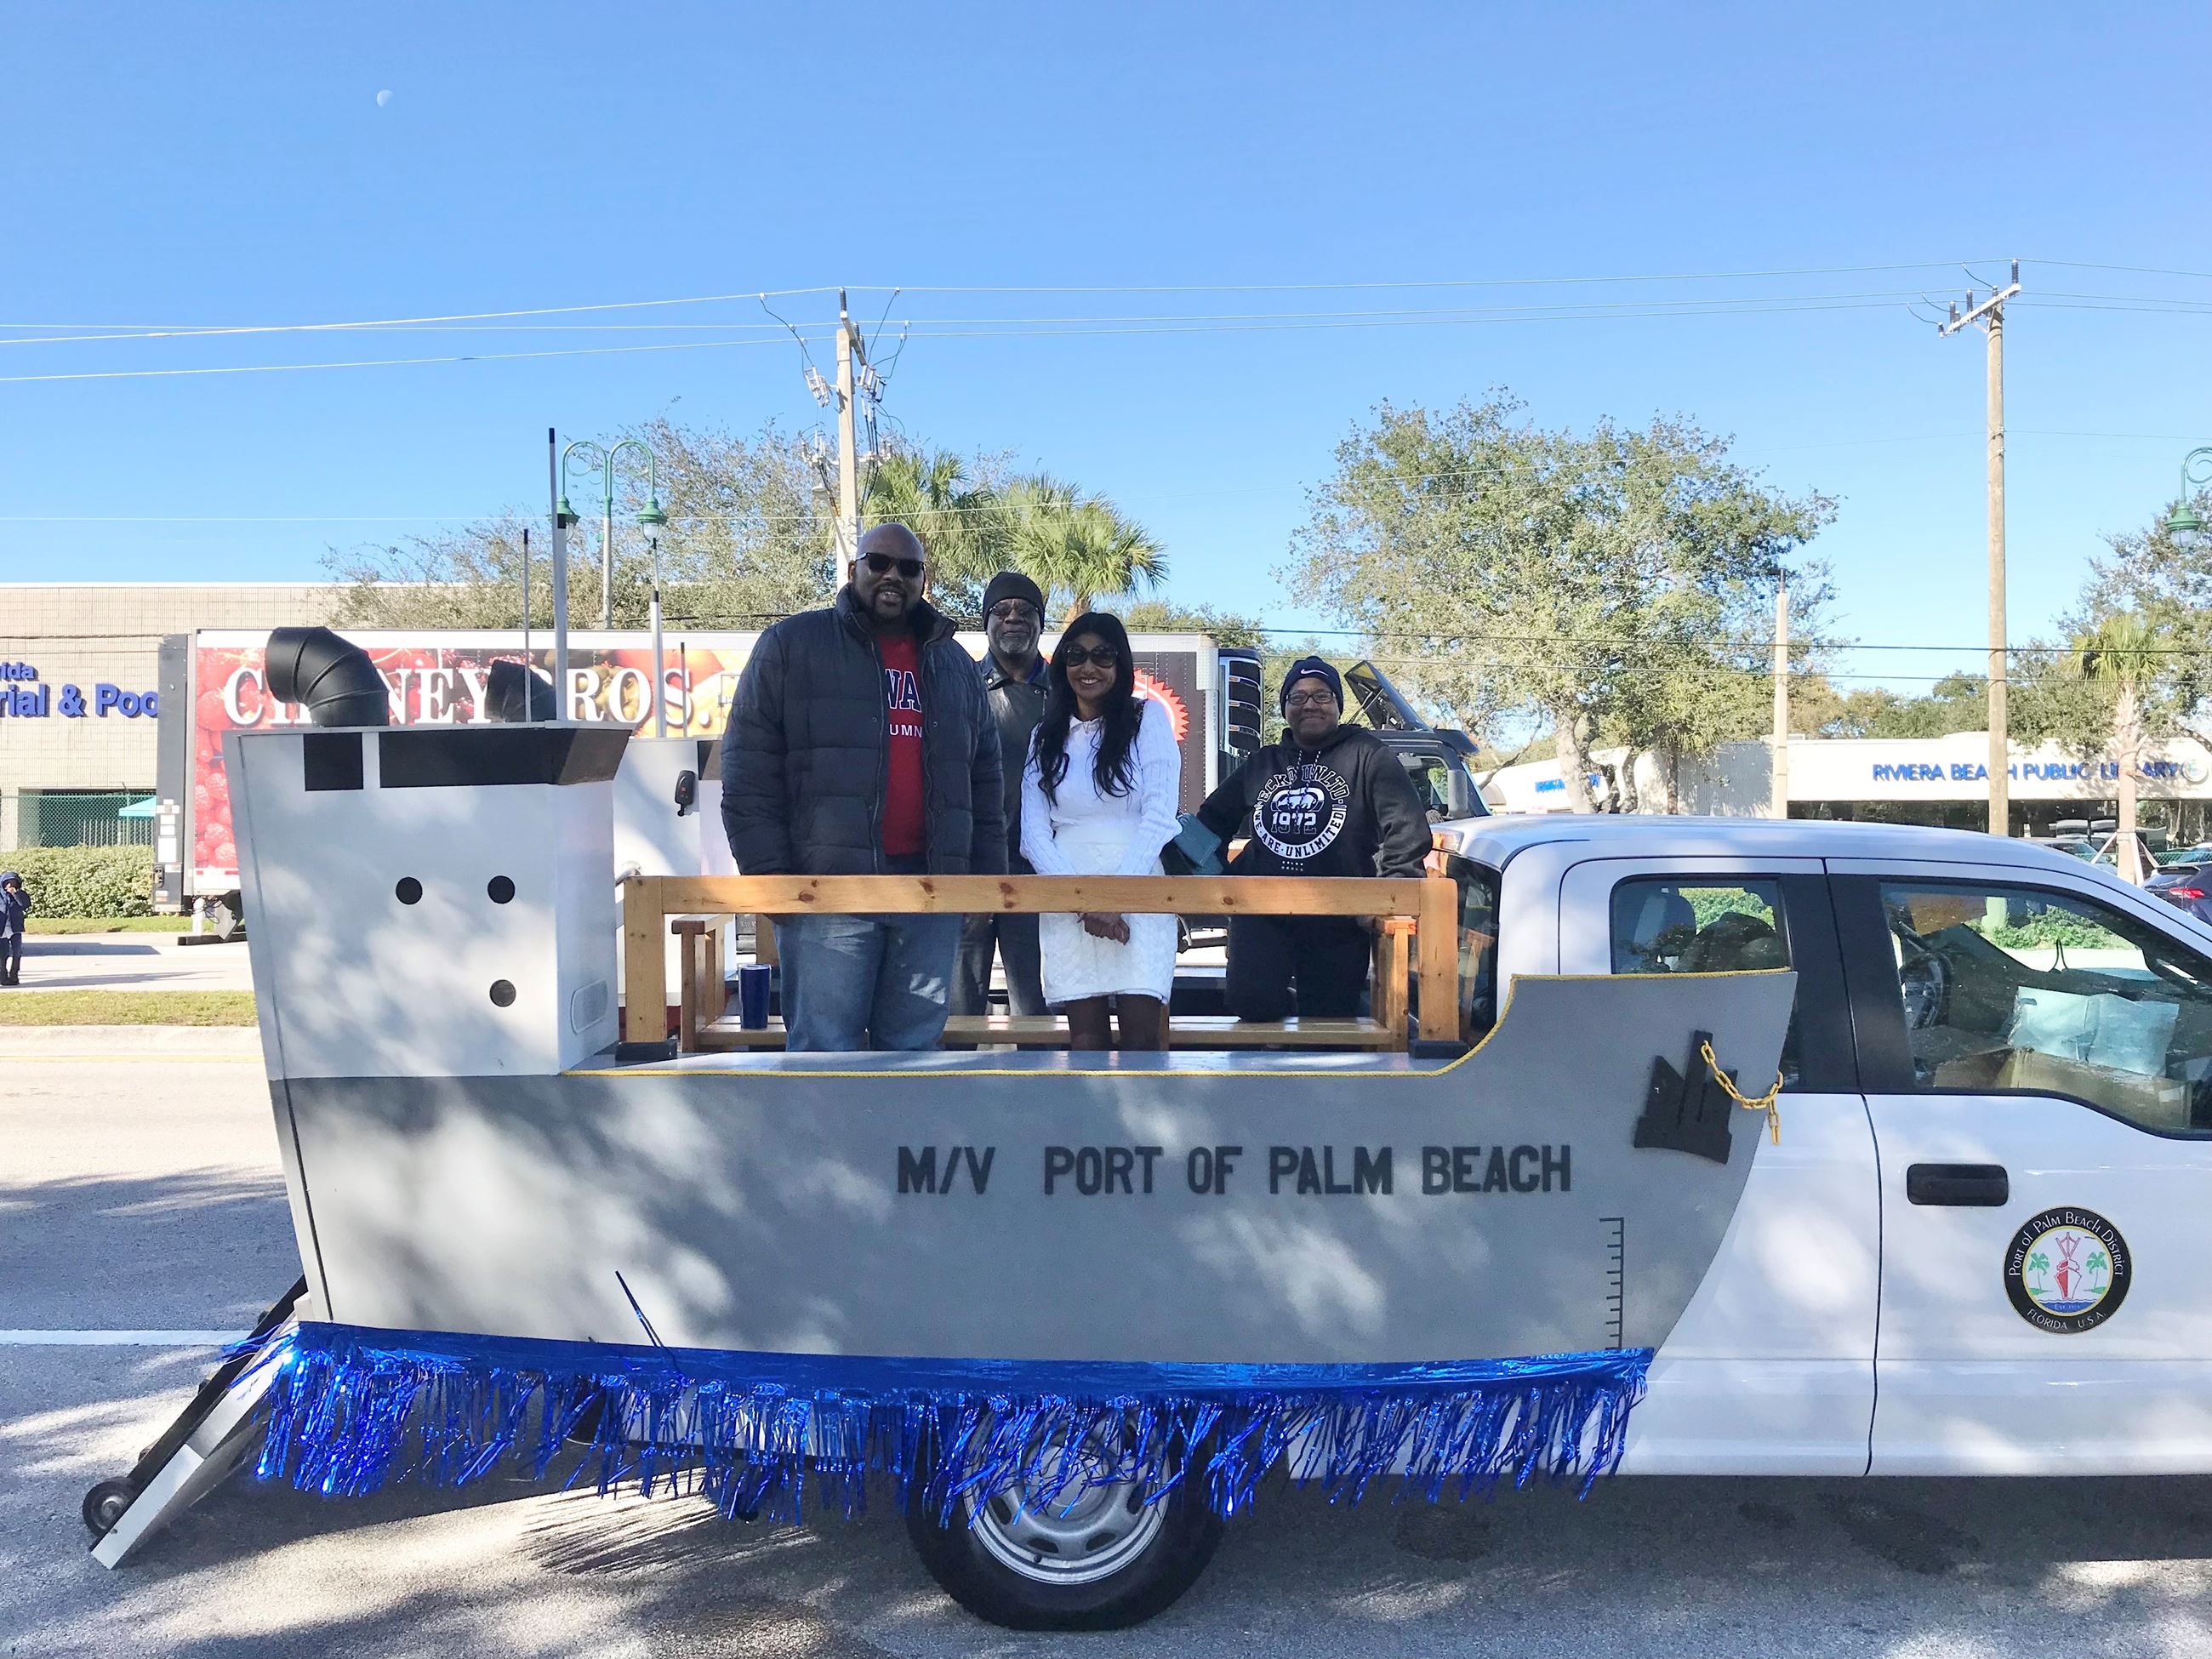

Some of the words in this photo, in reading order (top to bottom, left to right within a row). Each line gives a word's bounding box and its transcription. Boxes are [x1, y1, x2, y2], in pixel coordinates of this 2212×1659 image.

[58, 683, 86, 717] &
[224, 668, 491, 725] CNEY
[529, 668, 711, 726] ROS.
[1873, 763, 1946, 781] RIVIERA
[1951, 763, 2017, 781] BEAH
[2022, 762, 2090, 780] PUBLIC
[1254, 812, 1263, 830] WE
[1262, 833, 1281, 852] ARE
[1286, 812, 1345, 858] UNLIMITED
[1271, 811, 1317, 835] 1972
[898, 1146, 995, 1194] M/V
[1044, 1146, 1164, 1195] PORT
[1188, 1146, 1243, 1194] OF
[1269, 1146, 1394, 1194] PALM
[1422, 1145, 1571, 1194] BEACH
[2027, 1308, 2067, 1330] FLORIDA
